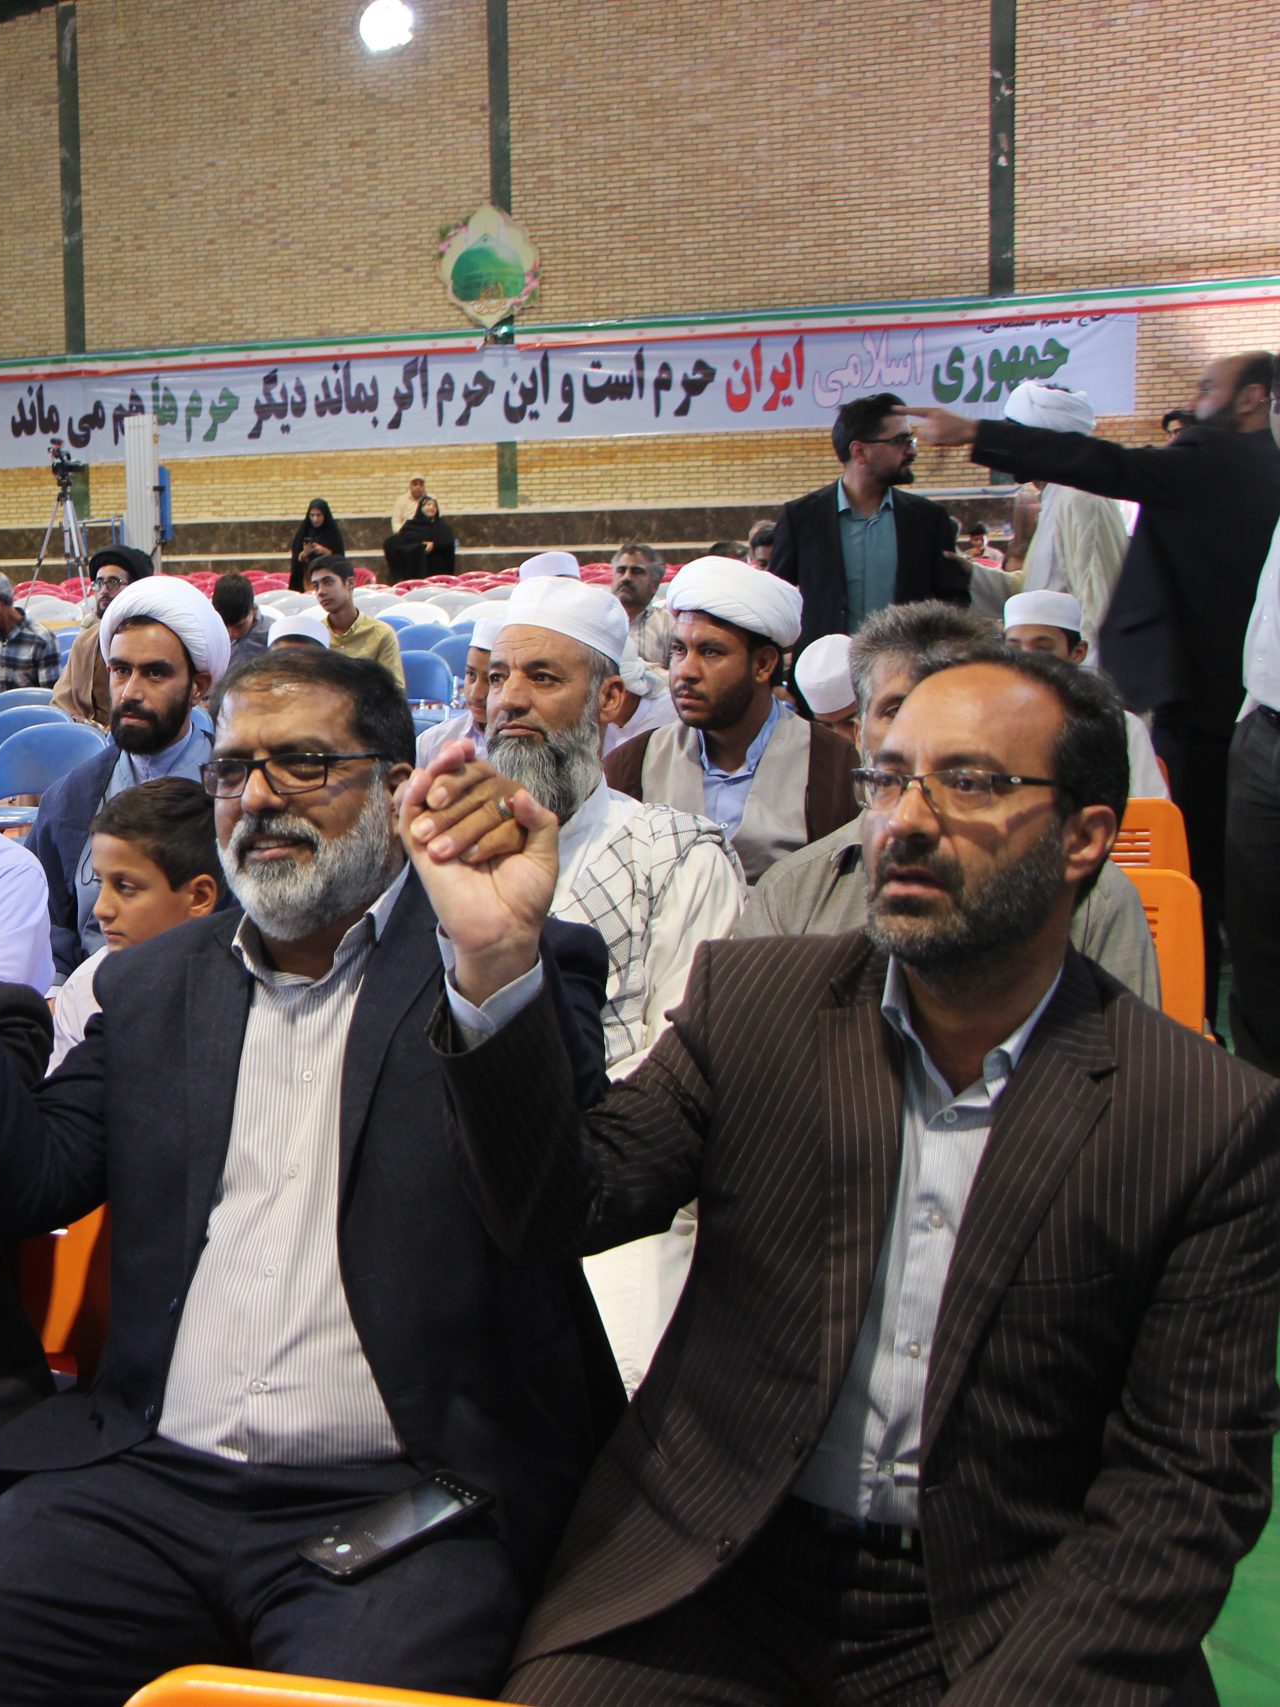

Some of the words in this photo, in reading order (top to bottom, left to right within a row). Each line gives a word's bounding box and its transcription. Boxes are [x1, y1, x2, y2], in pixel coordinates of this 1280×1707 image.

[314, 360, 380, 428] بماند
[387, 353, 429, 430] اگر
[436, 370, 496, 428] حرم
[503, 349, 550, 424] این
[557, 373, 574, 423] و
[582, 346, 646, 404] است
[653, 358, 717, 418] حرم
[725, 334, 805, 413] ایران
[812, 327, 925, 408] اسلامی
[932, 338, 1071, 404] جمهوری
[10, 383, 61, 438] ماند
[67, 400, 106, 448] می
[112, 387, 146, 446] هم
[247, 367, 307, 440] دیگر
